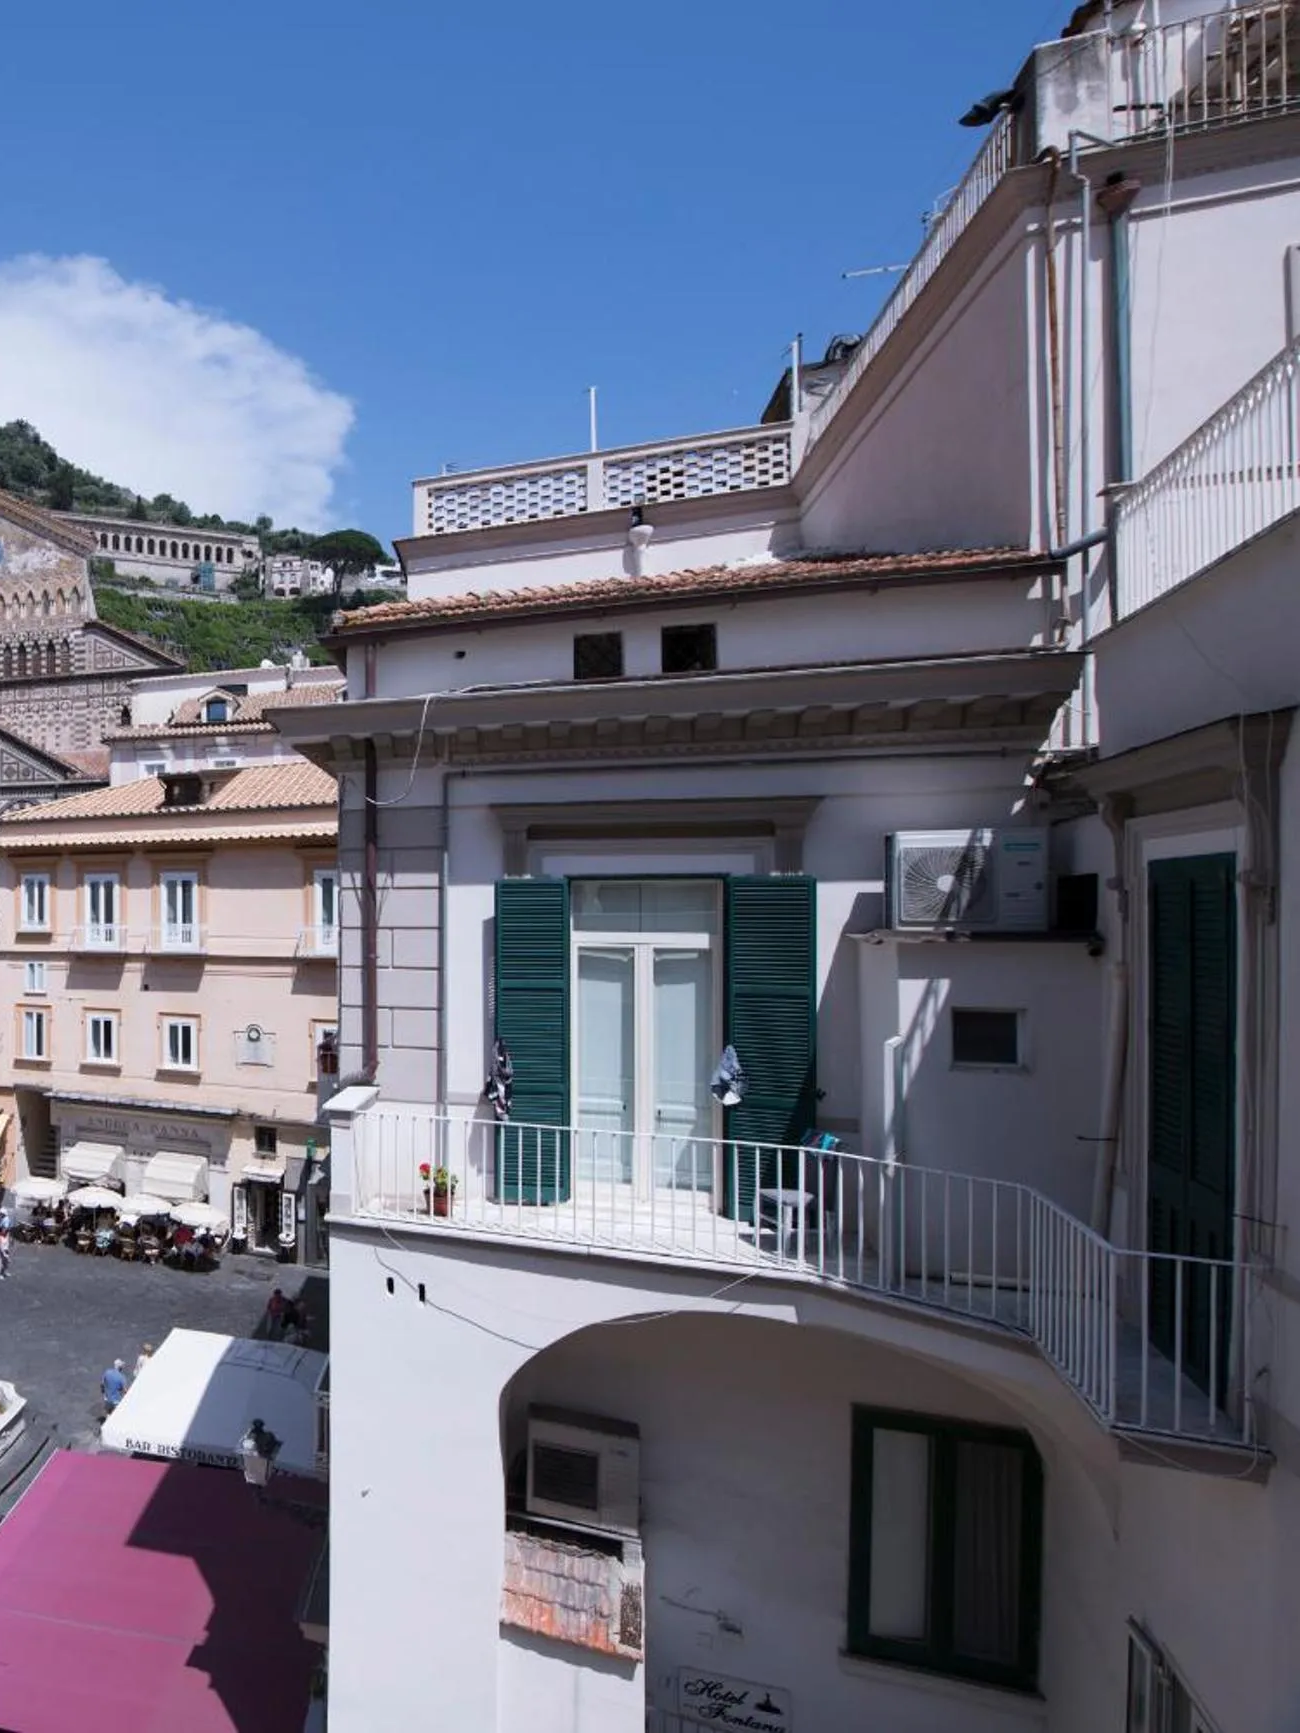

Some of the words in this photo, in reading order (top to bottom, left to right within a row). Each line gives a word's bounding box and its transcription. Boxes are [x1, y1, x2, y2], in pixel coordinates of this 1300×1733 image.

[125, 1438, 151, 1451] BAR
[683, 1678, 750, 1705] Hotel
[698, 1702, 786, 1733] Fontana
